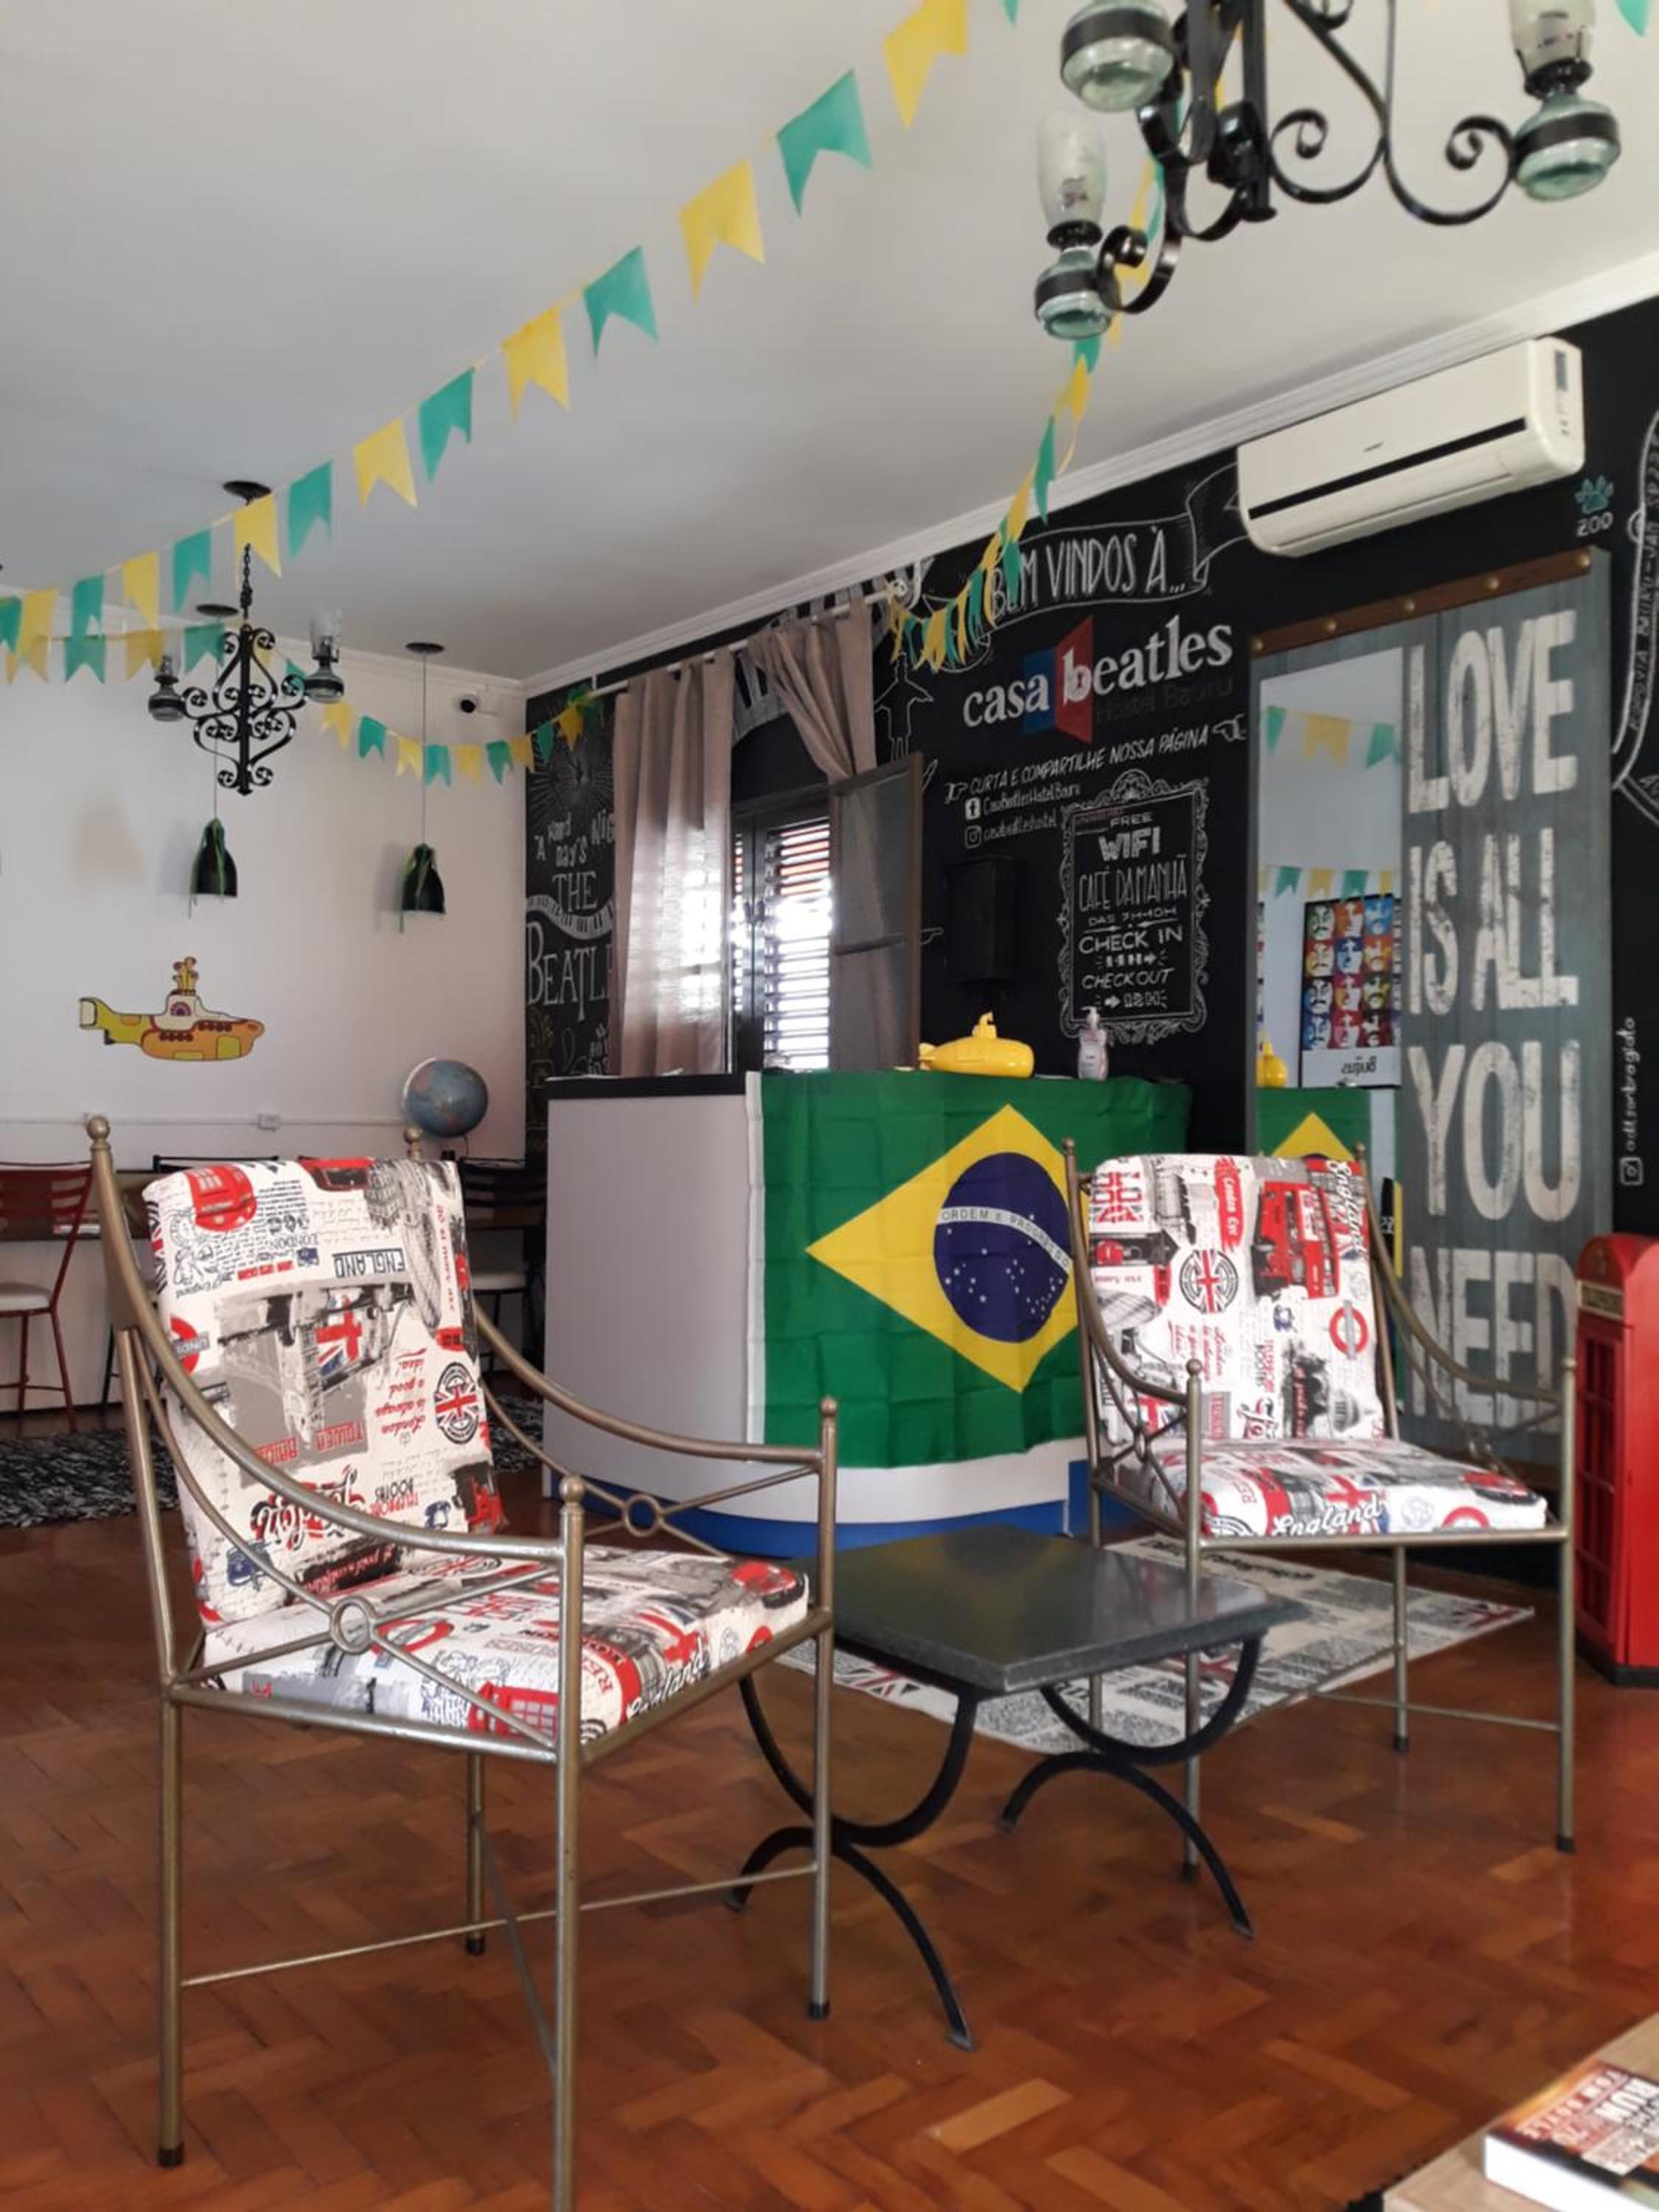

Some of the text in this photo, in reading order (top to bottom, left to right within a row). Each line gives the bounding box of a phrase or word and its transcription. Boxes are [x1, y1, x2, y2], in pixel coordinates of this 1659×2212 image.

[1576, 512, 1614, 537] 200
[1046, 531, 1137, 599] VINDOS
[962, 614, 1234, 728] casa beatles
[1408, 609, 1579, 813] LOVE
[970, 723, 1209, 794] CURTA E COMPARTILHE NOSSA PÁGINA
[1110, 811, 1153, 827] FREE
[1098, 825, 1161, 862] WIFI
[552, 871, 598, 912] THE
[1079, 865, 1111, 912] CAFÉ
[1079, 925, 1183, 954] CHECK IN
[1409, 827, 1579, 1016] IS ALL
[1408, 1040, 1581, 1222] YOU
[270, 1233, 318, 1252] LONDON
[942, 1209, 1070, 1269] ORDEM E PROGRESSO
[334, 1251, 405, 1279] ENGLAND
[1409, 1246, 1576, 1433] NEED
[1273, 1492, 1384, 1535] England
